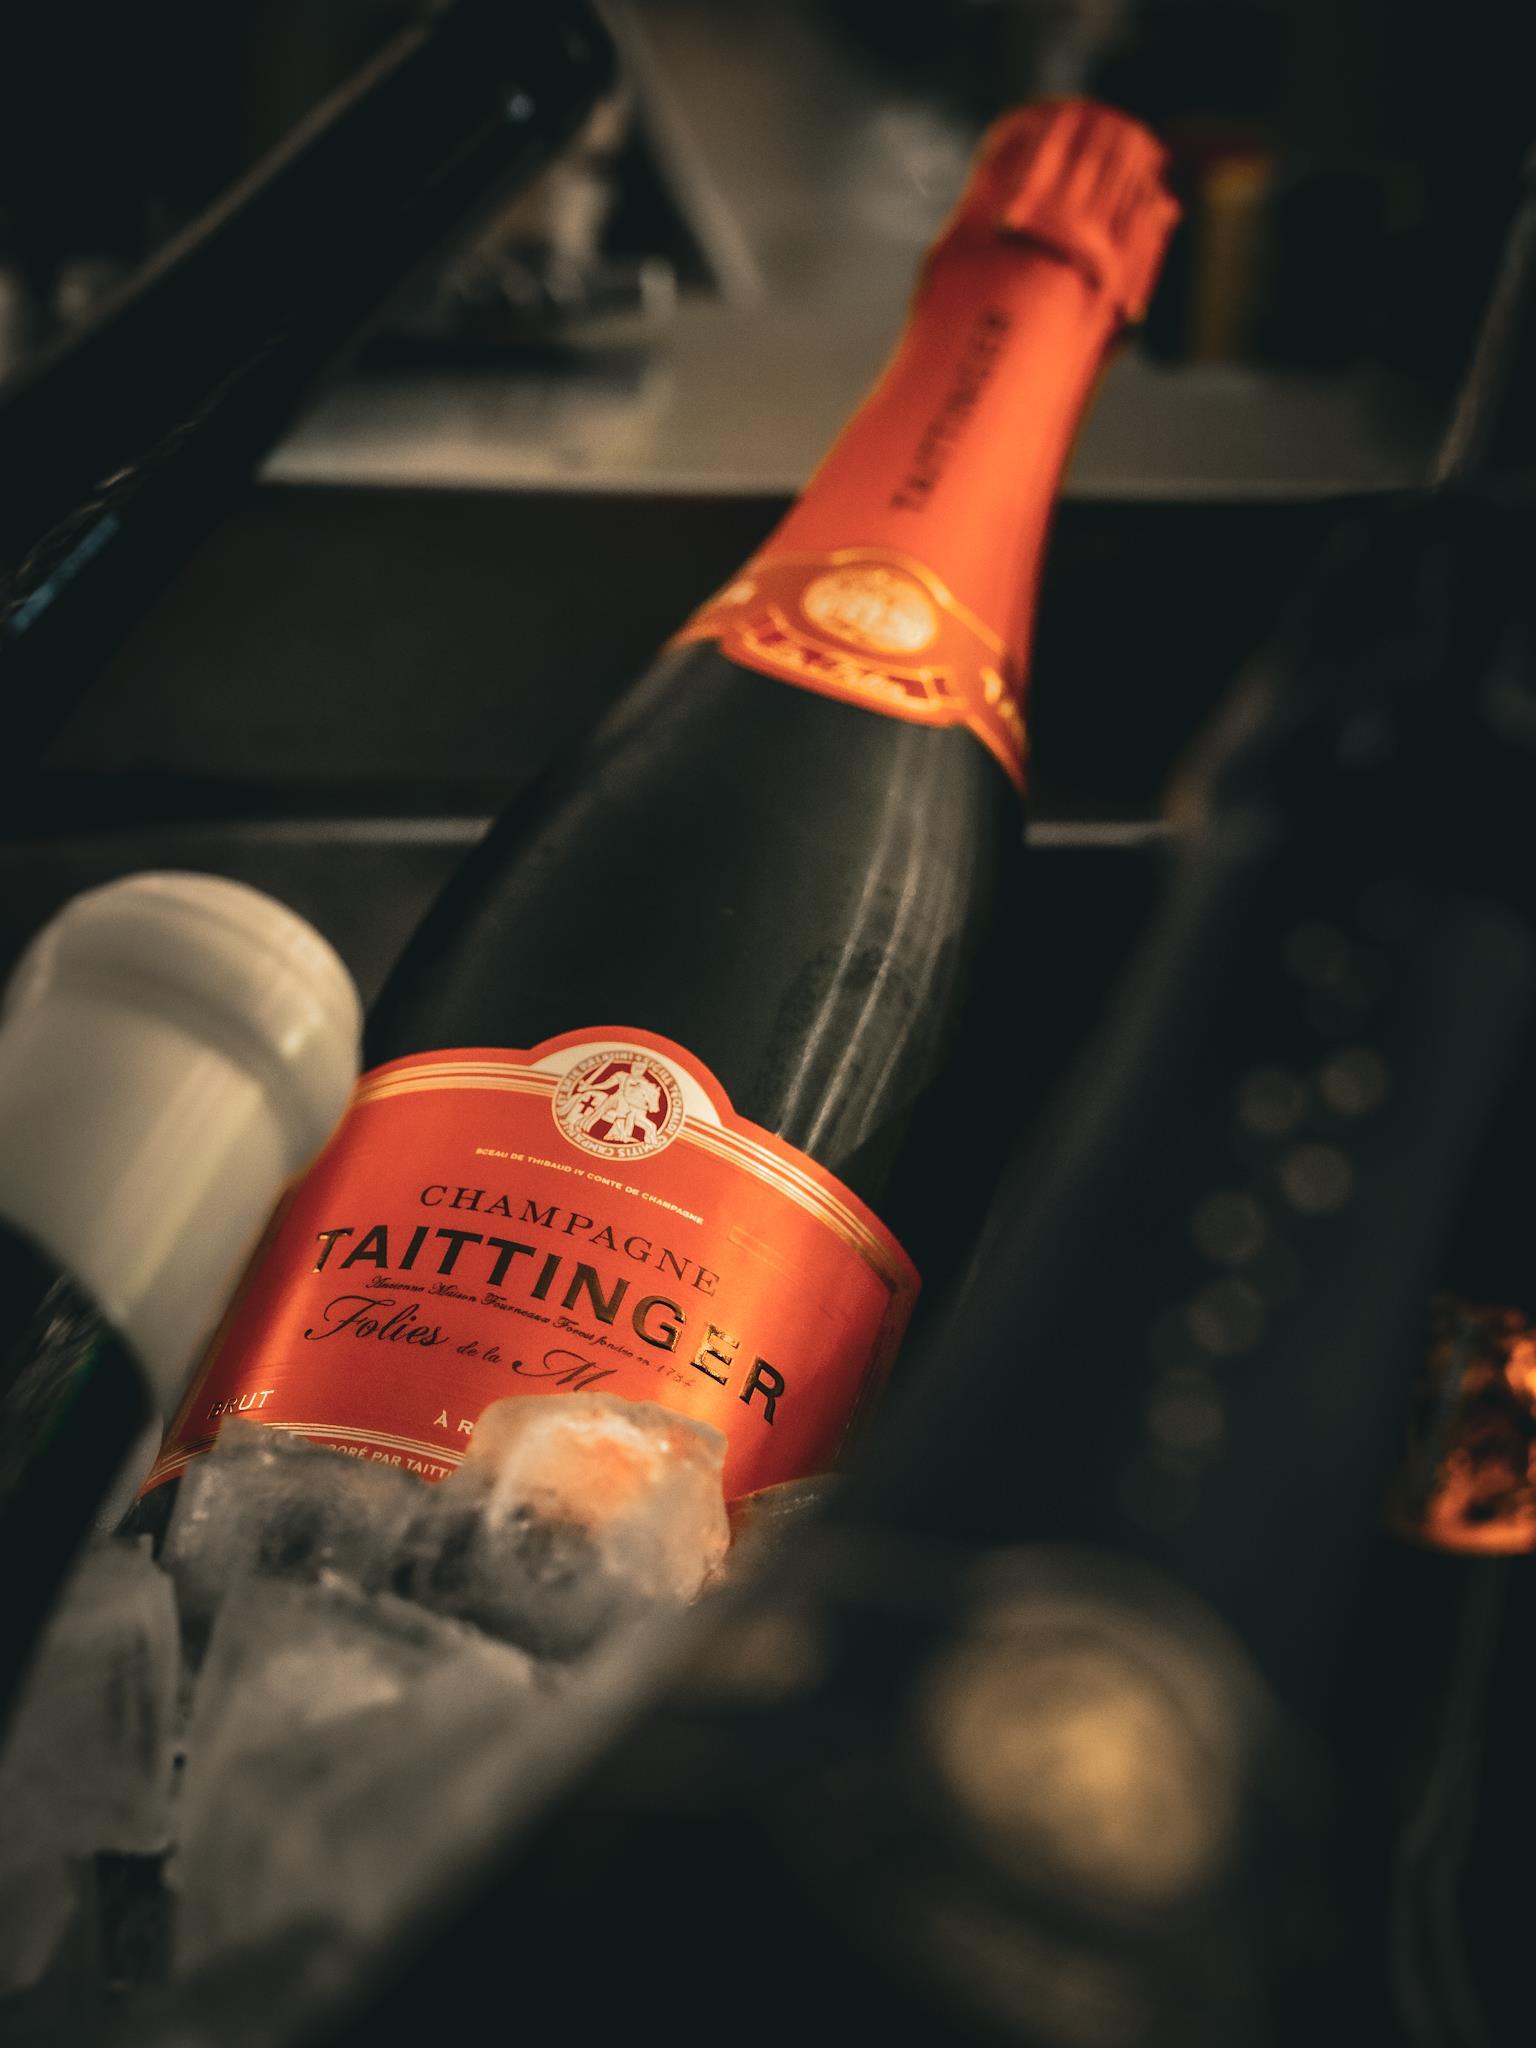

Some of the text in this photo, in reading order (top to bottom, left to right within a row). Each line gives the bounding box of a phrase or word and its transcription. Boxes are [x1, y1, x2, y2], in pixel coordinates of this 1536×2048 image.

[510, 1152, 525, 1162] DE
[527, 1156, 572, 1174] THIBAUD
[587, 1172, 623, 1190] COMTE
[624, 1185, 641, 1197] DE
[641, 1191, 704, 1226] CHAMPAGNE
[419, 1184, 721, 1297] CHAMPAGNE
[303, 1294, 619, 1393] Folies de la M
[311, 1224, 786, 1426] TAITTINGER
[206, 1389, 275, 1420] BRUT
[371, 1451, 402, 1467] PAR
